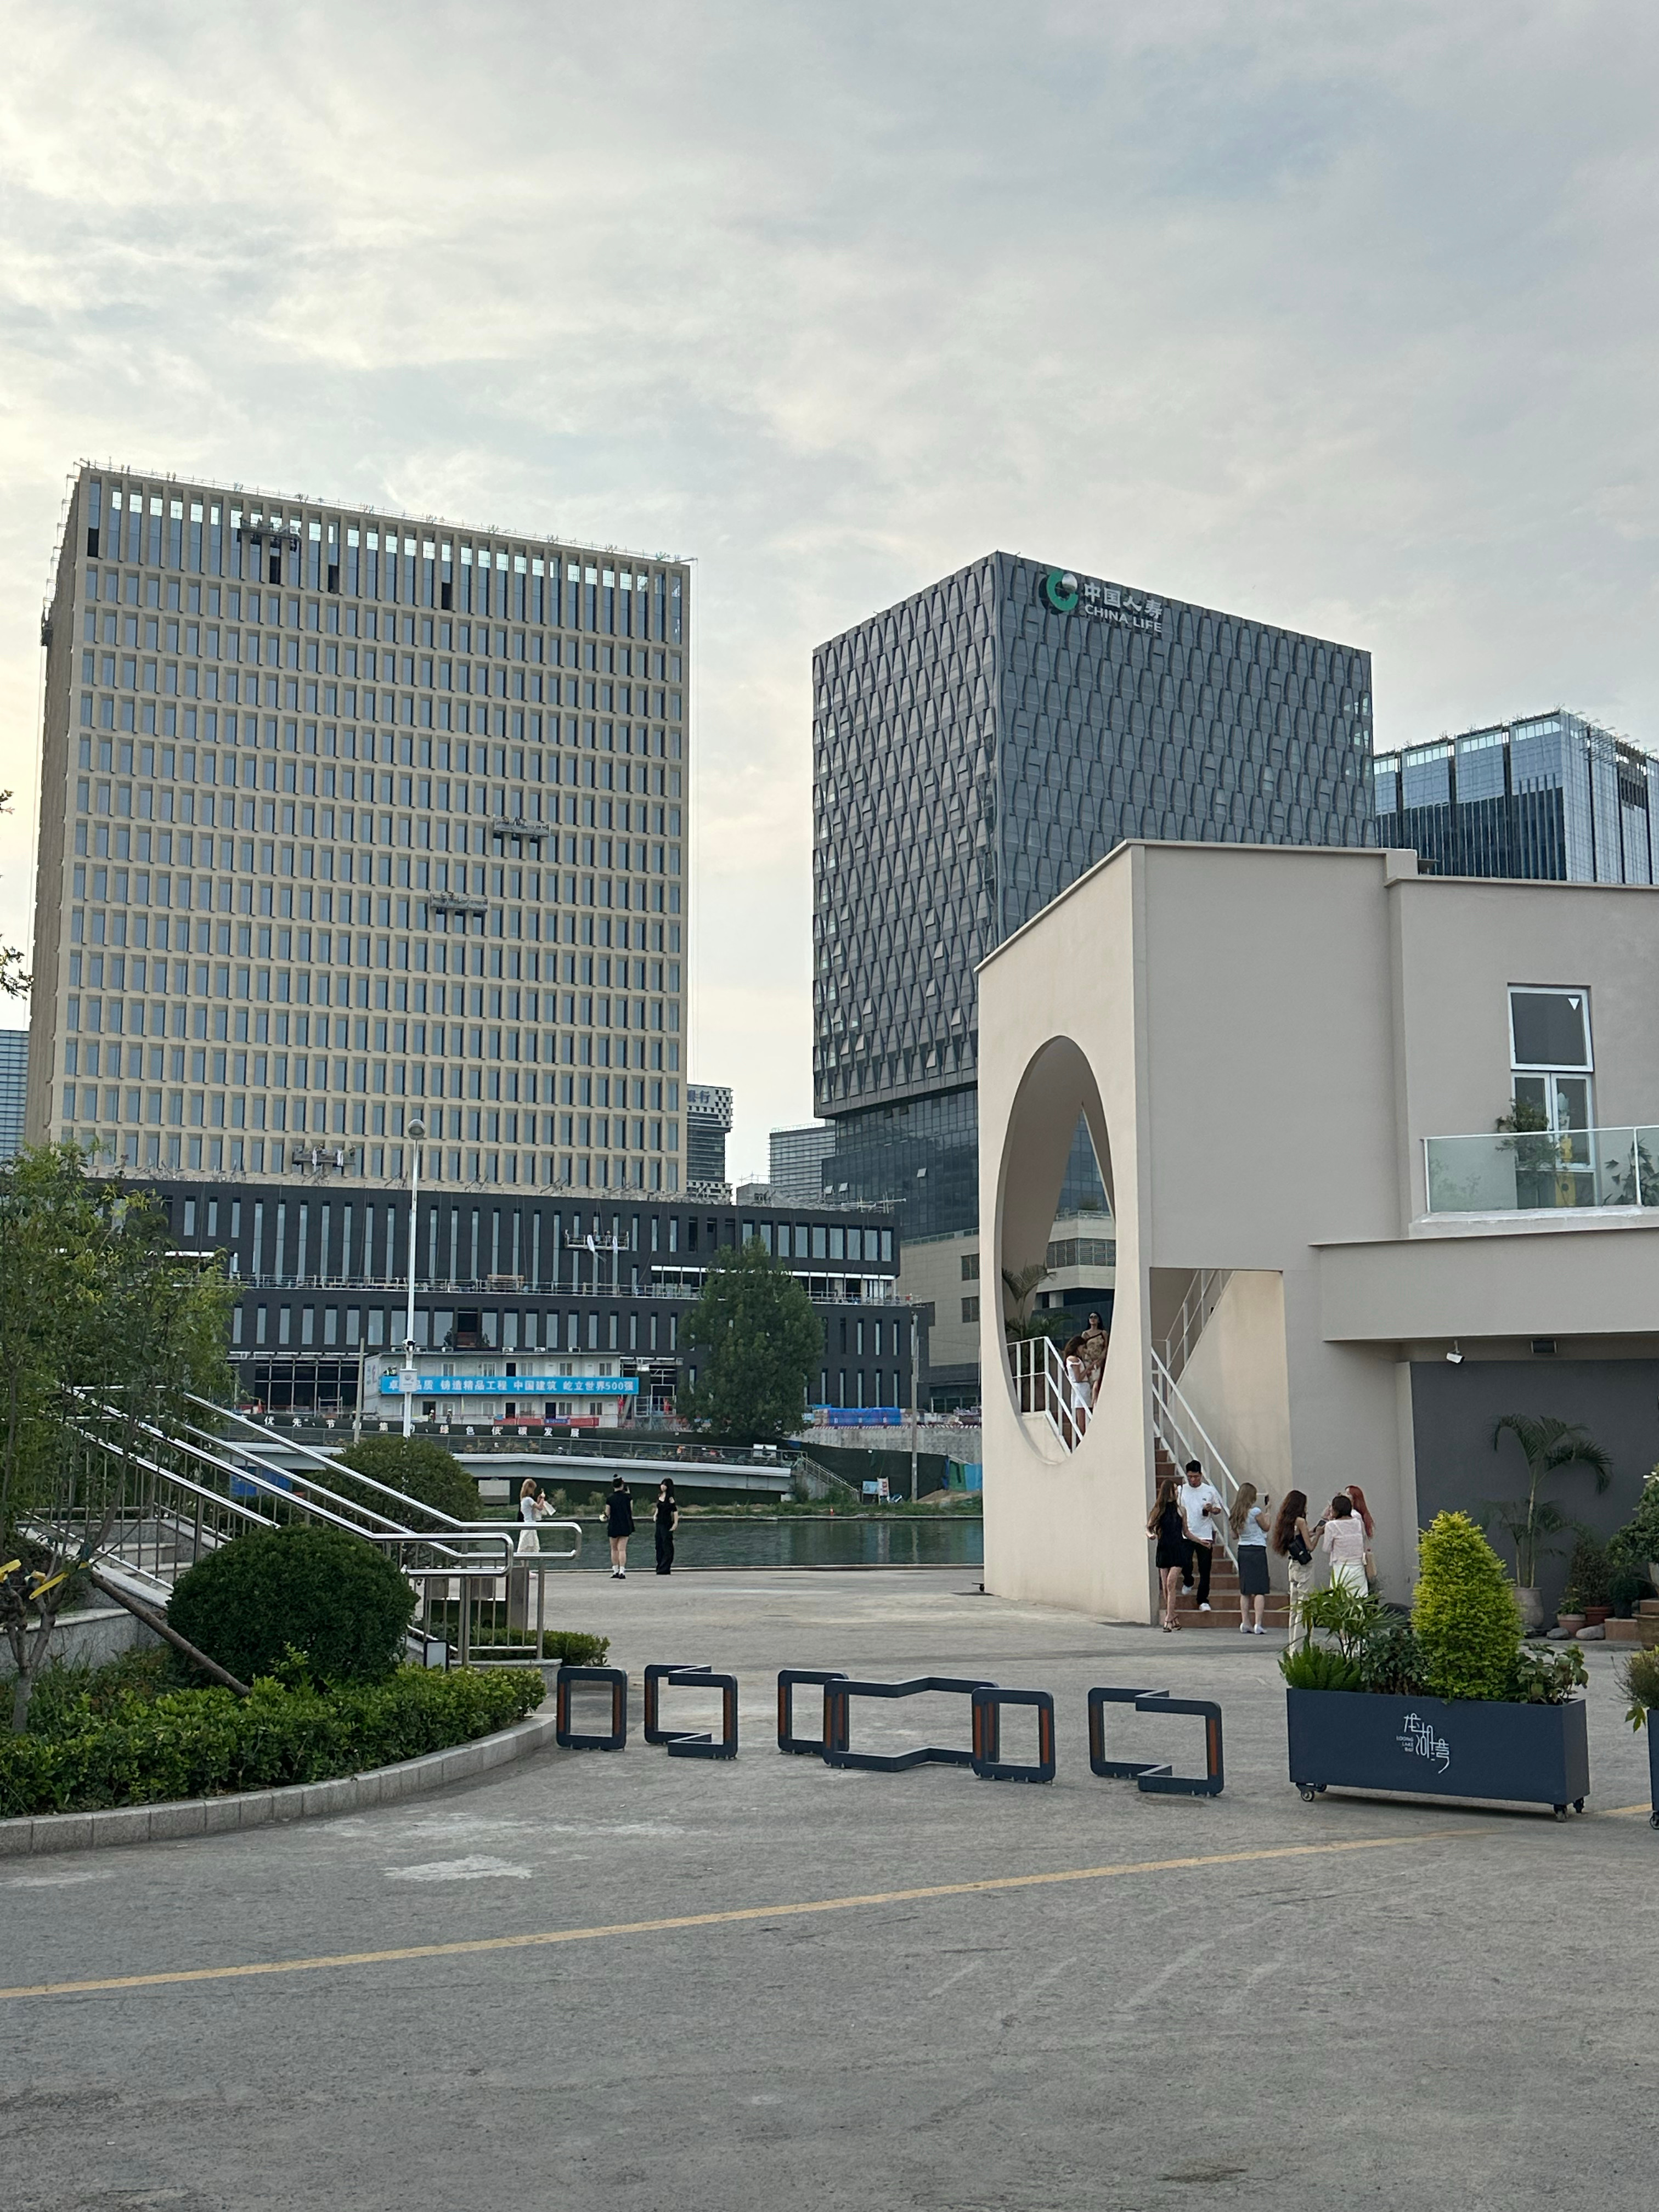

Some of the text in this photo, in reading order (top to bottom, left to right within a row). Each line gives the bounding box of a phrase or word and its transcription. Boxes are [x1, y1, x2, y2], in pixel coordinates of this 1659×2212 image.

[1084, 582, 1163, 619] 中国人寿
[1085, 604, 1163, 633] CHINA LIFE
[388, 1380, 433, 1390] 卓品质
[514, 1380, 557, 1391] 中国建筑
[563, 1380, 634, 1391] 屹立世界500强
